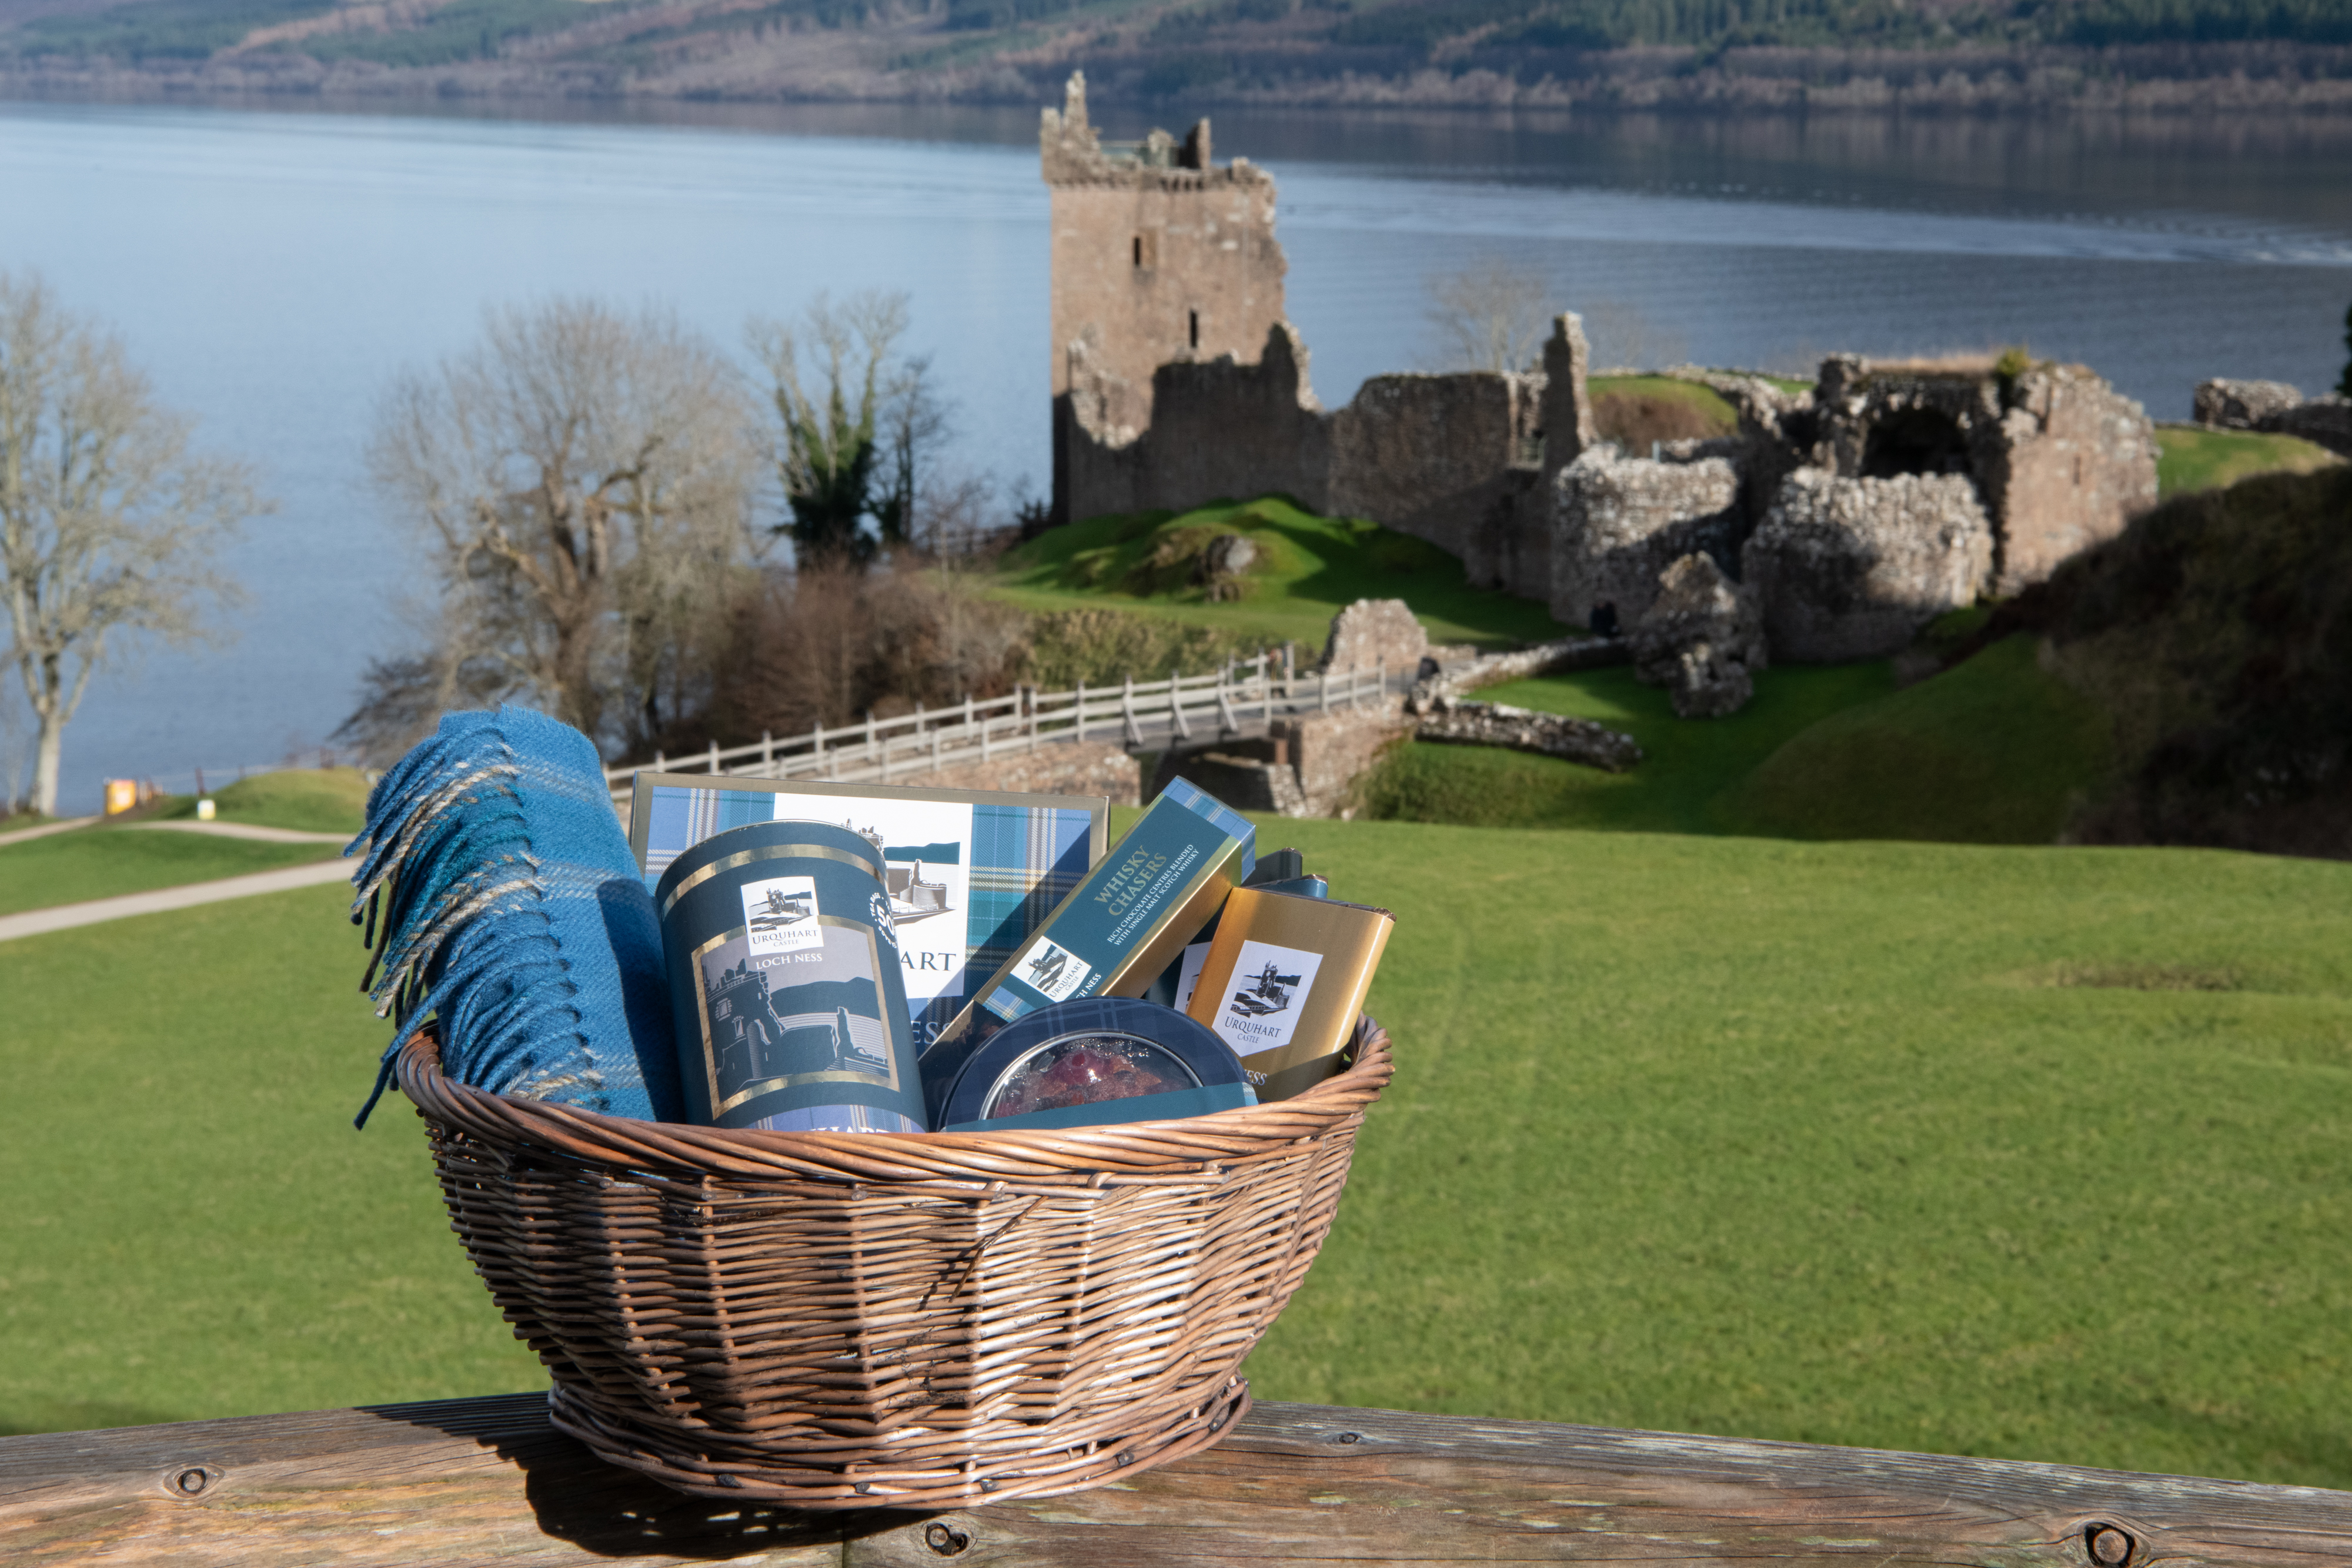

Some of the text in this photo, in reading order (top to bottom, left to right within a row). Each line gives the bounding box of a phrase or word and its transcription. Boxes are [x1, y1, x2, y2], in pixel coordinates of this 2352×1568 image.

[1094, 845, 1149, 903] WHISKY
[1108, 852, 1167, 916] CHASERS
[1107, 844, 1194, 942] RICH CHOCOLATE CENTRES BLENDED
[1114, 849, 1199, 946] WITH SINGLE MALT SCOTCH WHISKY
[877, 904, 894, 936] 50
[753, 930, 818, 944] URQUHART
[756, 954, 823, 969] LOCH NESS
[901, 951, 957, 971] ART
[1049, 961, 1083, 998] URQUHART
[1065, 976, 1079, 991] CASTLE
[1085, 973, 1101, 991] NESS
[1225, 1017, 1281, 1038] URQUHART
[1237, 1033, 1259, 1044] CASTLE
[1244, 1069, 1267, 1086] ESS
